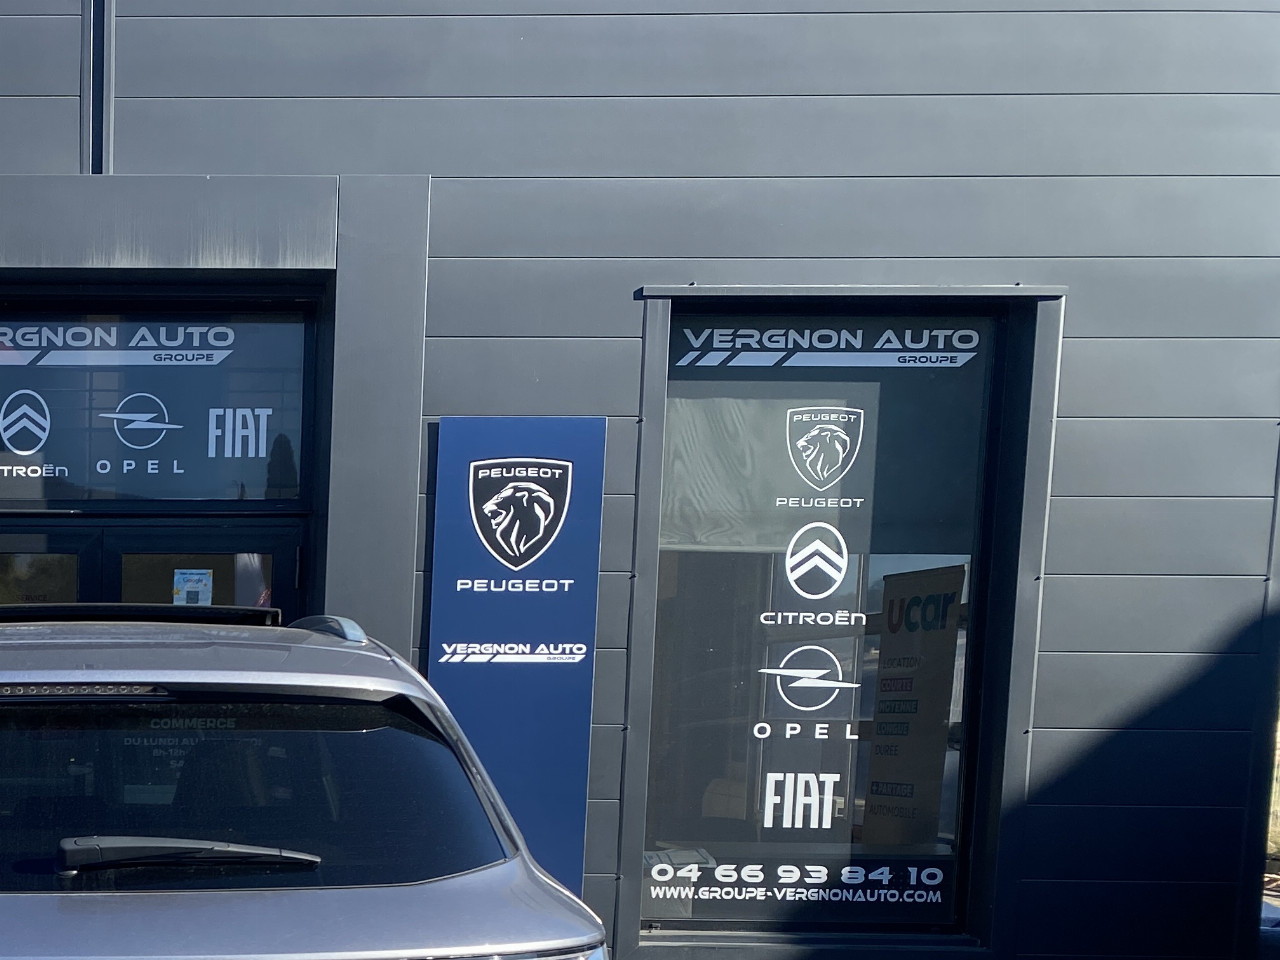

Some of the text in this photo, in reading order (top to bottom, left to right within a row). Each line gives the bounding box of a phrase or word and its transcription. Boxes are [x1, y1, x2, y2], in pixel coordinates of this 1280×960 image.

[128, 326, 235, 347] AUTO
[682, 328, 980, 349] VERGNON AUTO
[153, 353, 215, 362] GROUPE
[897, 355, 958, 365] GROUPE
[793, 413, 858, 423] PEUGEOT
[207, 408, 273, 458] FIAT
[96, 459, 185, 474] OPEL
[478, 467, 563, 479] PEUGEOT
[776, 498, 865, 508] PEUGEOT
[456, 579, 575, 592] PEUGEOT
[441, 643, 587, 654] VERGNON AUTO
[881, 679, 913, 691] COURTE
[150, 718, 236, 729] COMMERCE
[753, 722, 860, 740] OPEL
[123, 737, 140, 746] DU
[763, 772, 841, 829] FIAT
[650, 863, 944, 885] 04 66 93 84 10
[650, 885, 942, 903] WWW.GROUPE-VERGNONAUTO.COM
